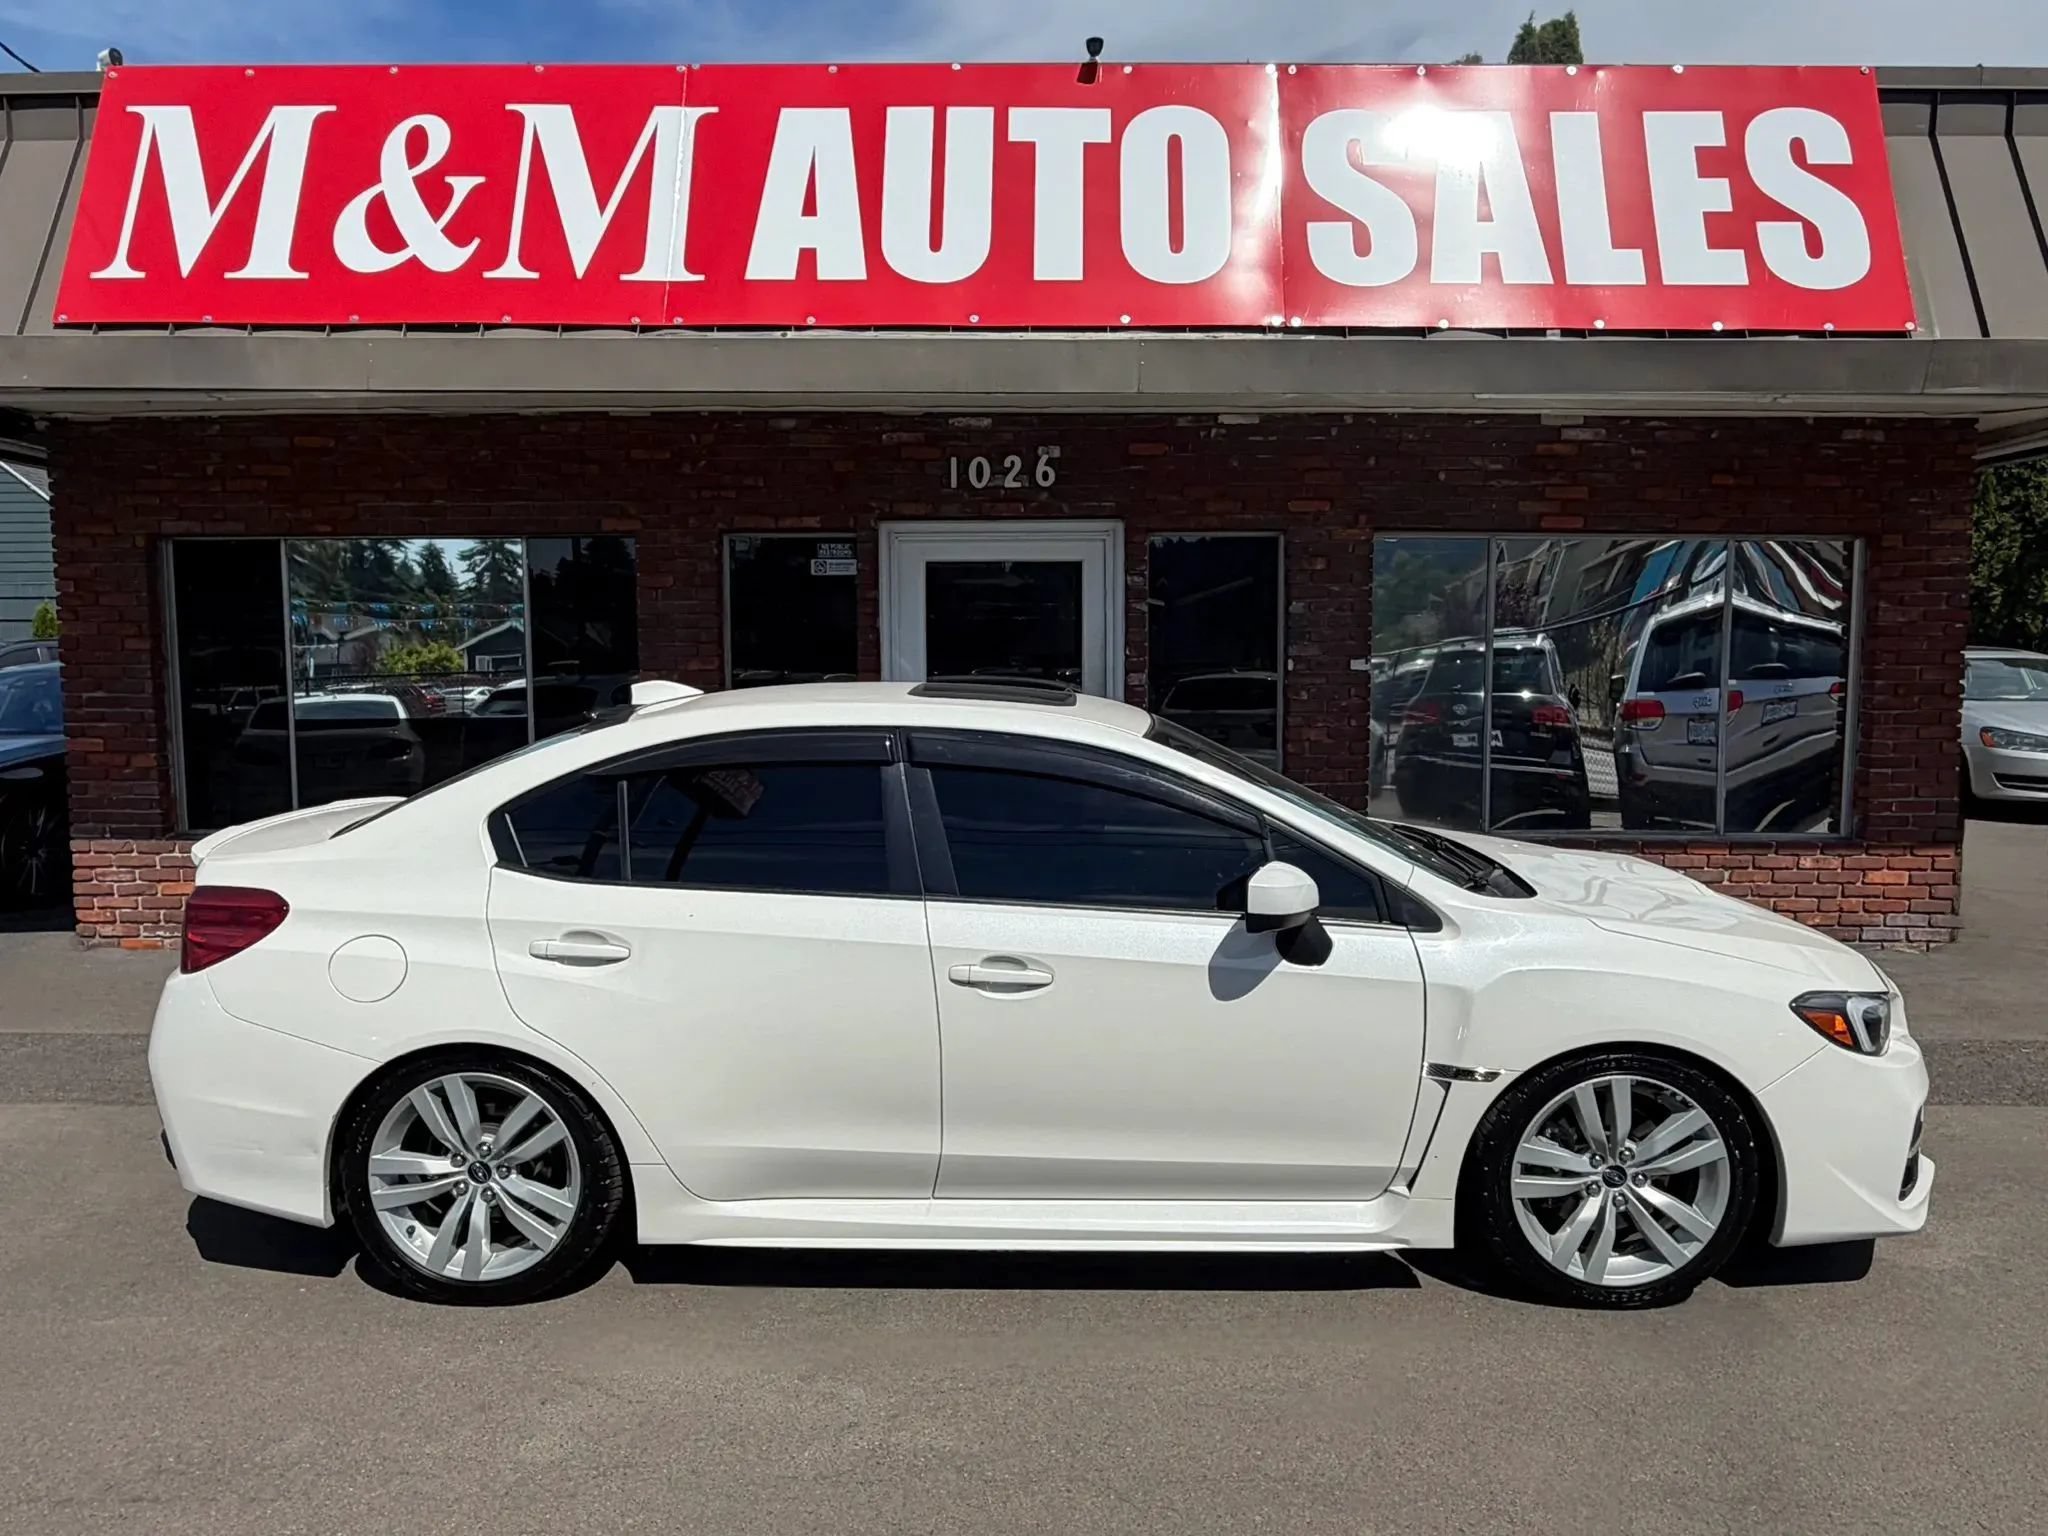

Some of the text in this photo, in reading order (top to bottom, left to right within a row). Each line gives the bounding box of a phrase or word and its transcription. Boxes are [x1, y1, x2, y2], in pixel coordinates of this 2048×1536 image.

[90, 104, 1871, 290] M&M AUTO SALES
[950, 454, 1056, 489] 1026
